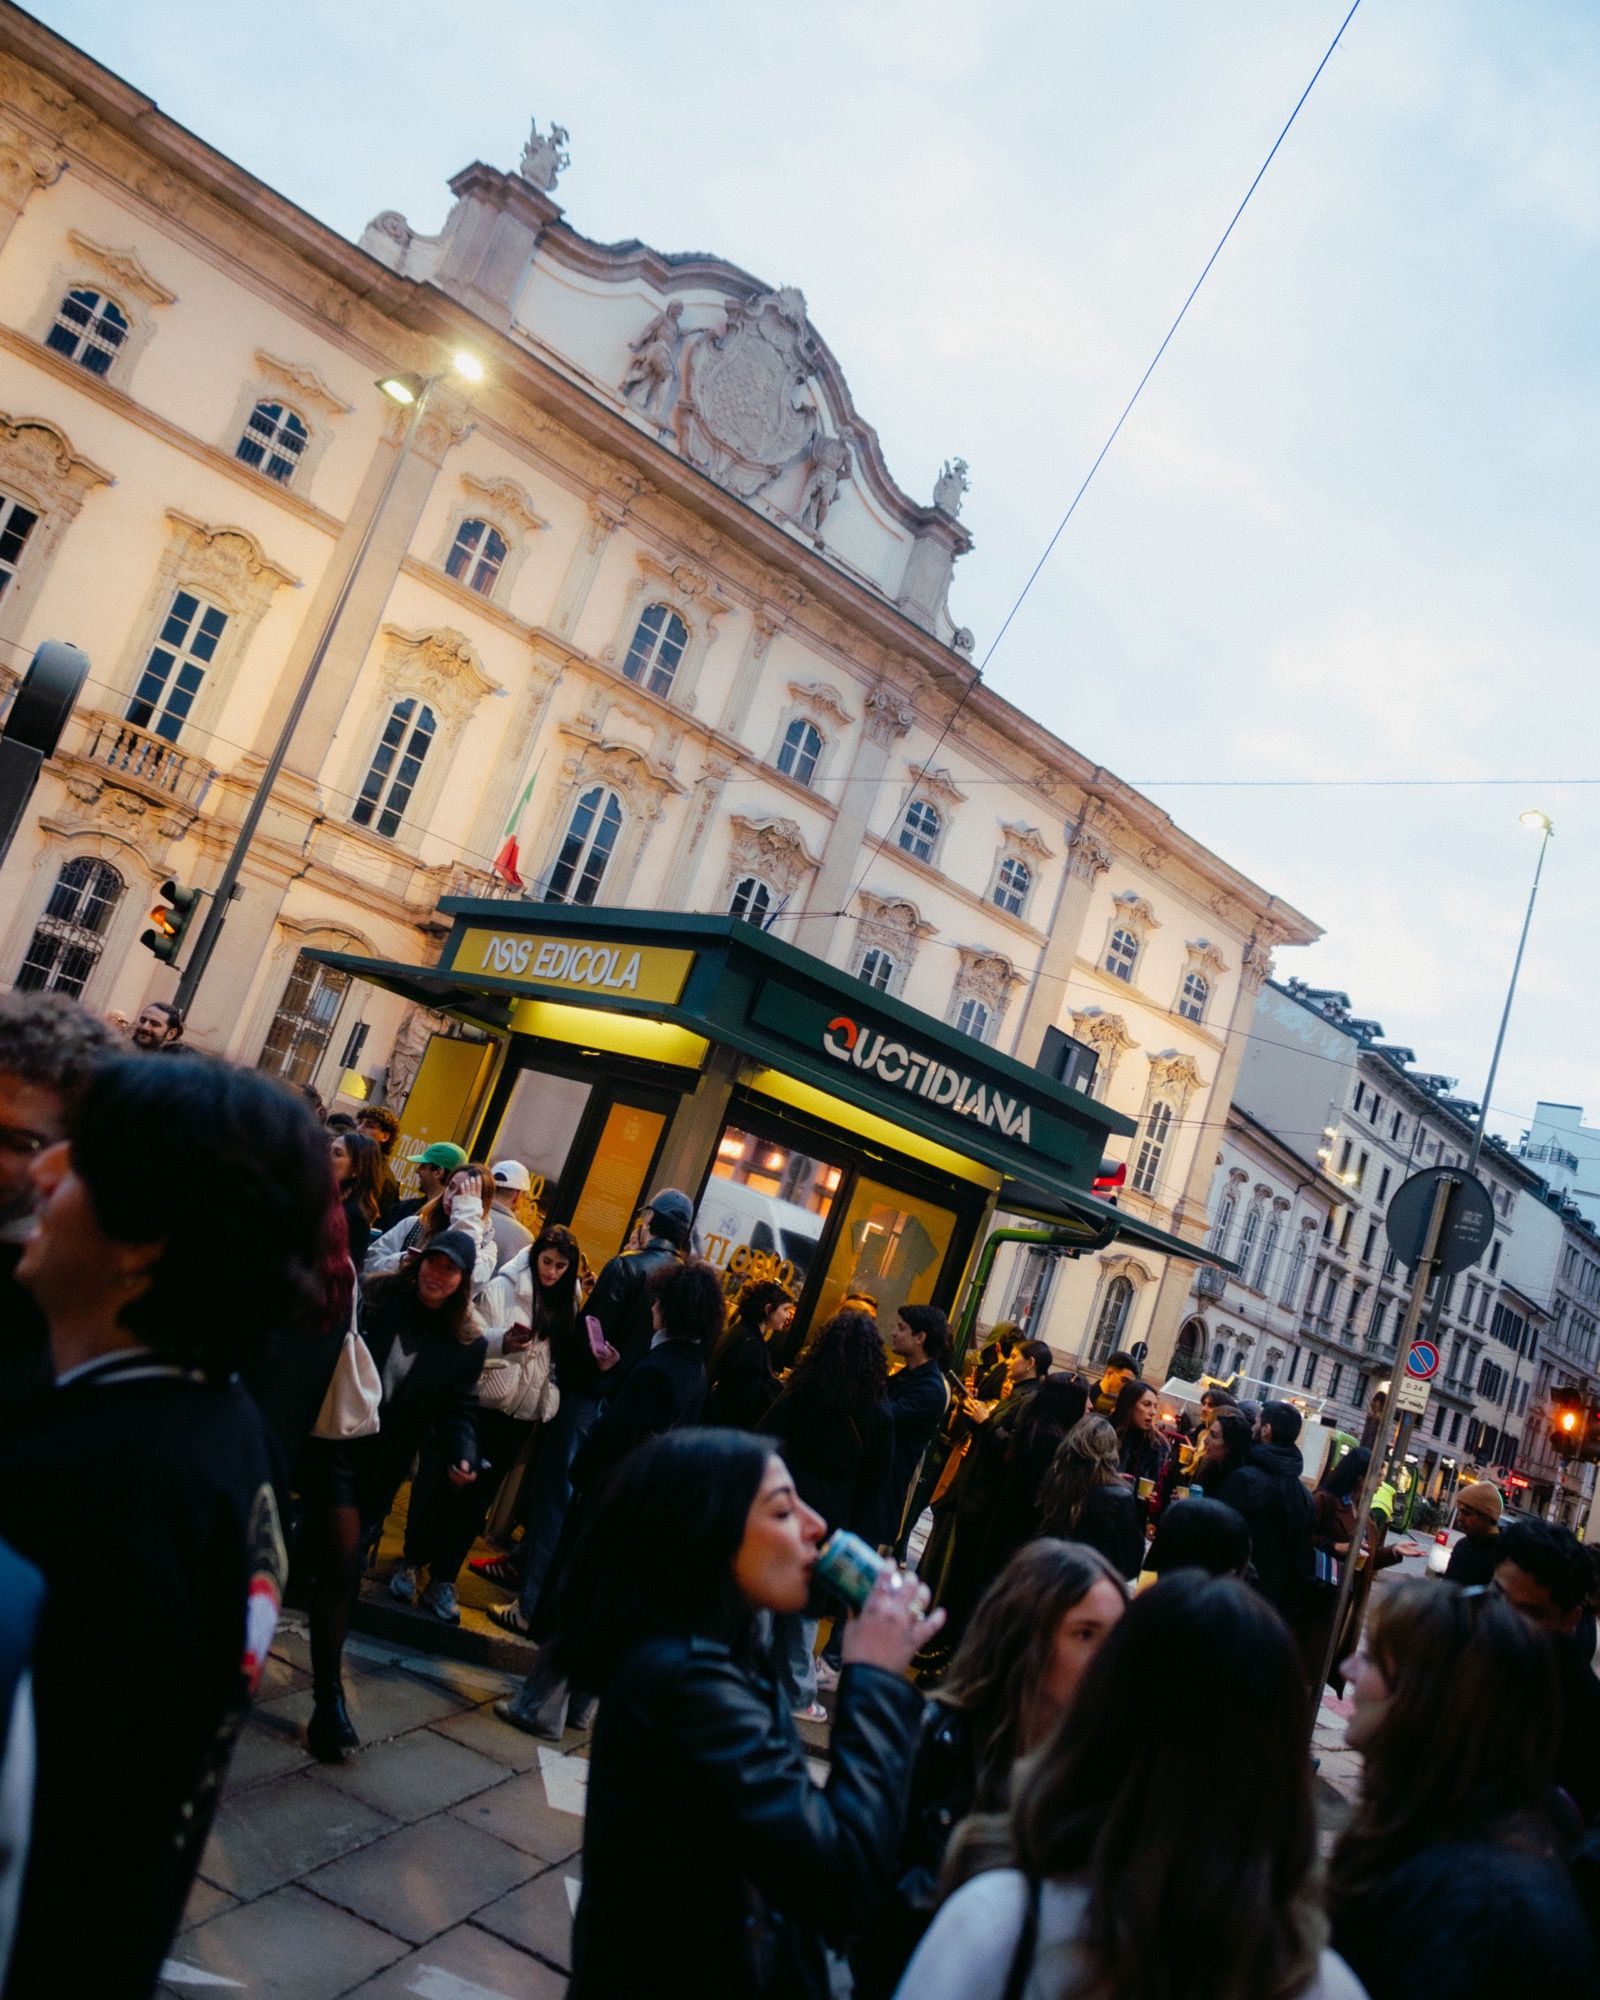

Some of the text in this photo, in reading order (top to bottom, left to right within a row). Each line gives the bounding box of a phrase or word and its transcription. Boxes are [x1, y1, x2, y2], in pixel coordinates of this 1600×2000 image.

[532, 942, 641, 990] EDICOLA
[823, 1016, 1031, 1144] QUOTIDIANA
[703, 1231, 731, 1265] TI
